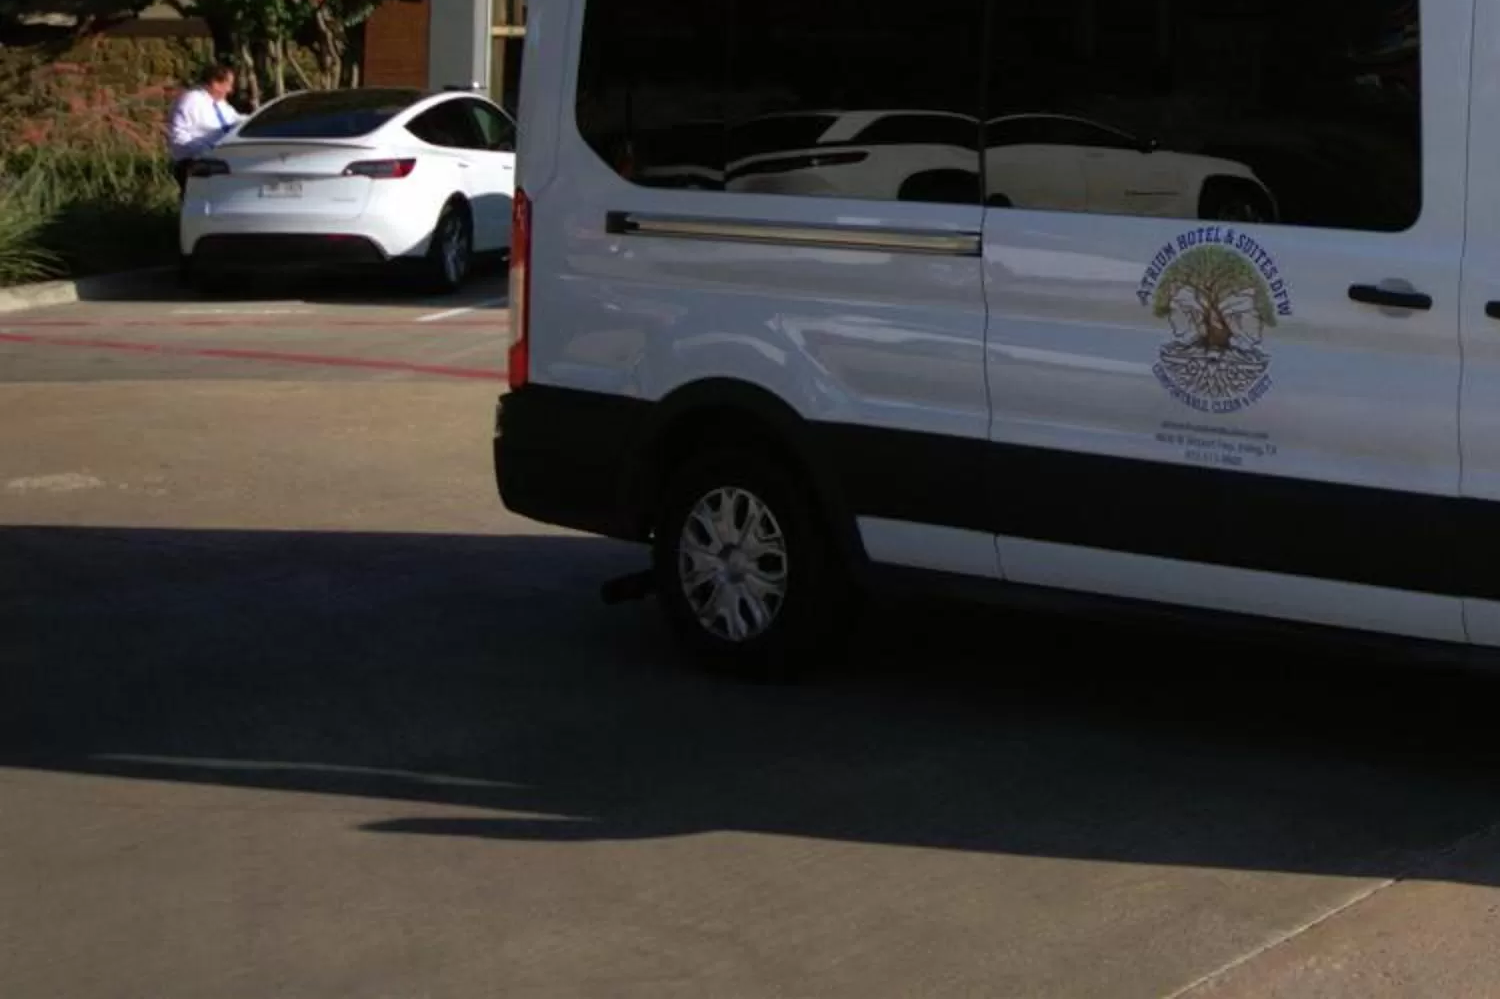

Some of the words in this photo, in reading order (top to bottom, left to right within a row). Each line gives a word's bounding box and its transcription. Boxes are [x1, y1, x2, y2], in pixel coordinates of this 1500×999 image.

[1136, 242, 1177, 306] ATRIUM
[1176, 226, 1222, 251] HOTEL
[1224, 228, 1235, 244] &
[1235, 233, 1278, 280] SUITES
[1270, 274, 1293, 316] DFW
